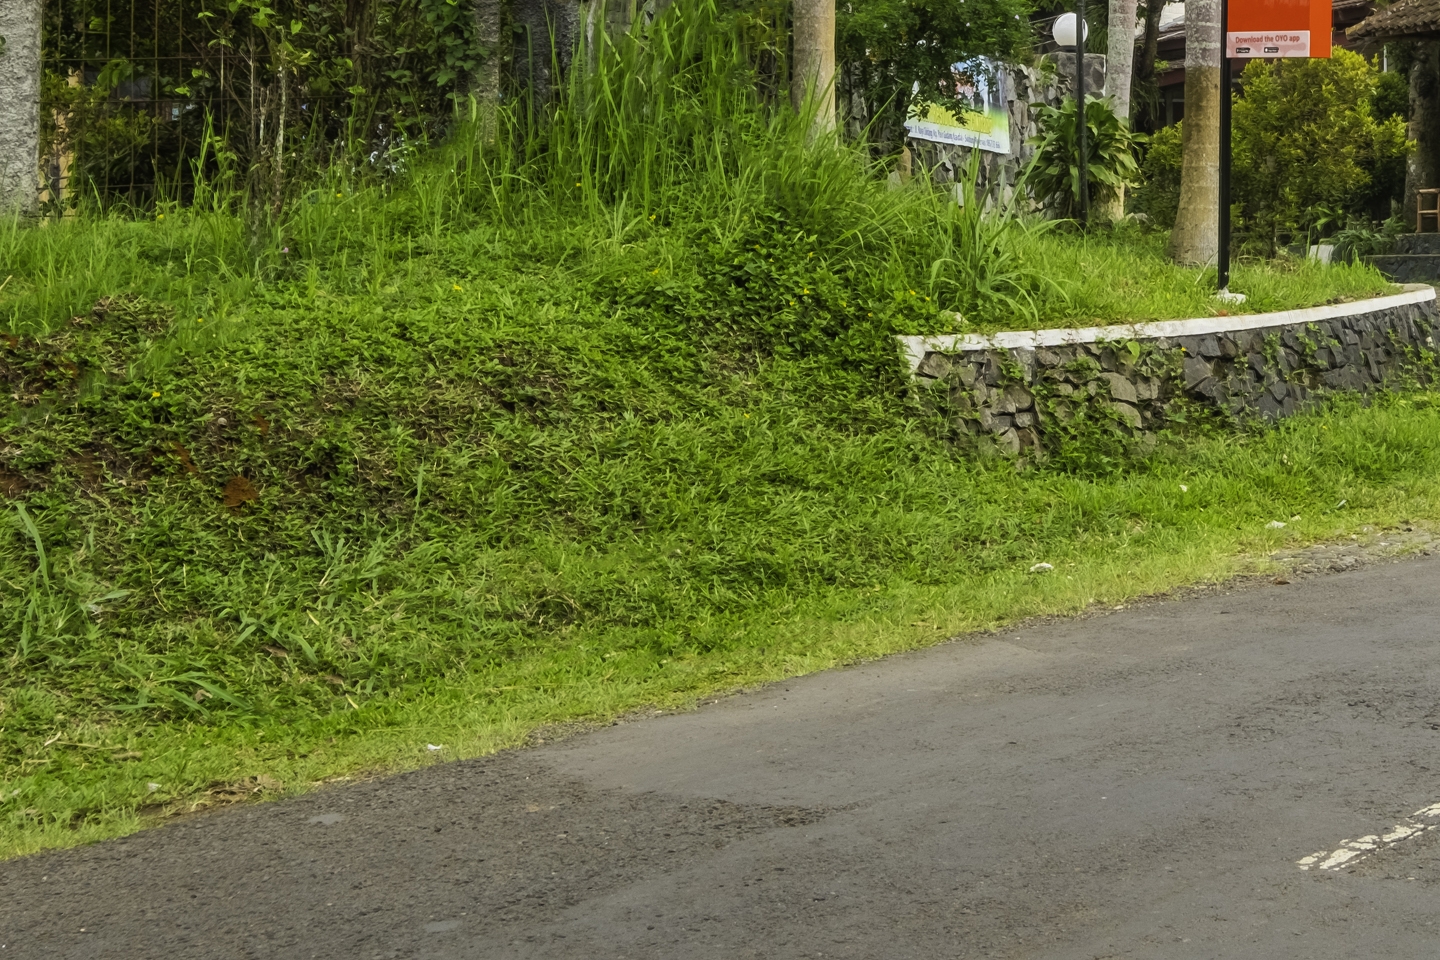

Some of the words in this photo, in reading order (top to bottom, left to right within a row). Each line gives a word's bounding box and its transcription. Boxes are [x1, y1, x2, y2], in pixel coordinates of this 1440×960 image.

[1235, 36, 1263, 44] Download
[1264, 35, 1274, 43] the
[1289, 35, 1300, 43] app
